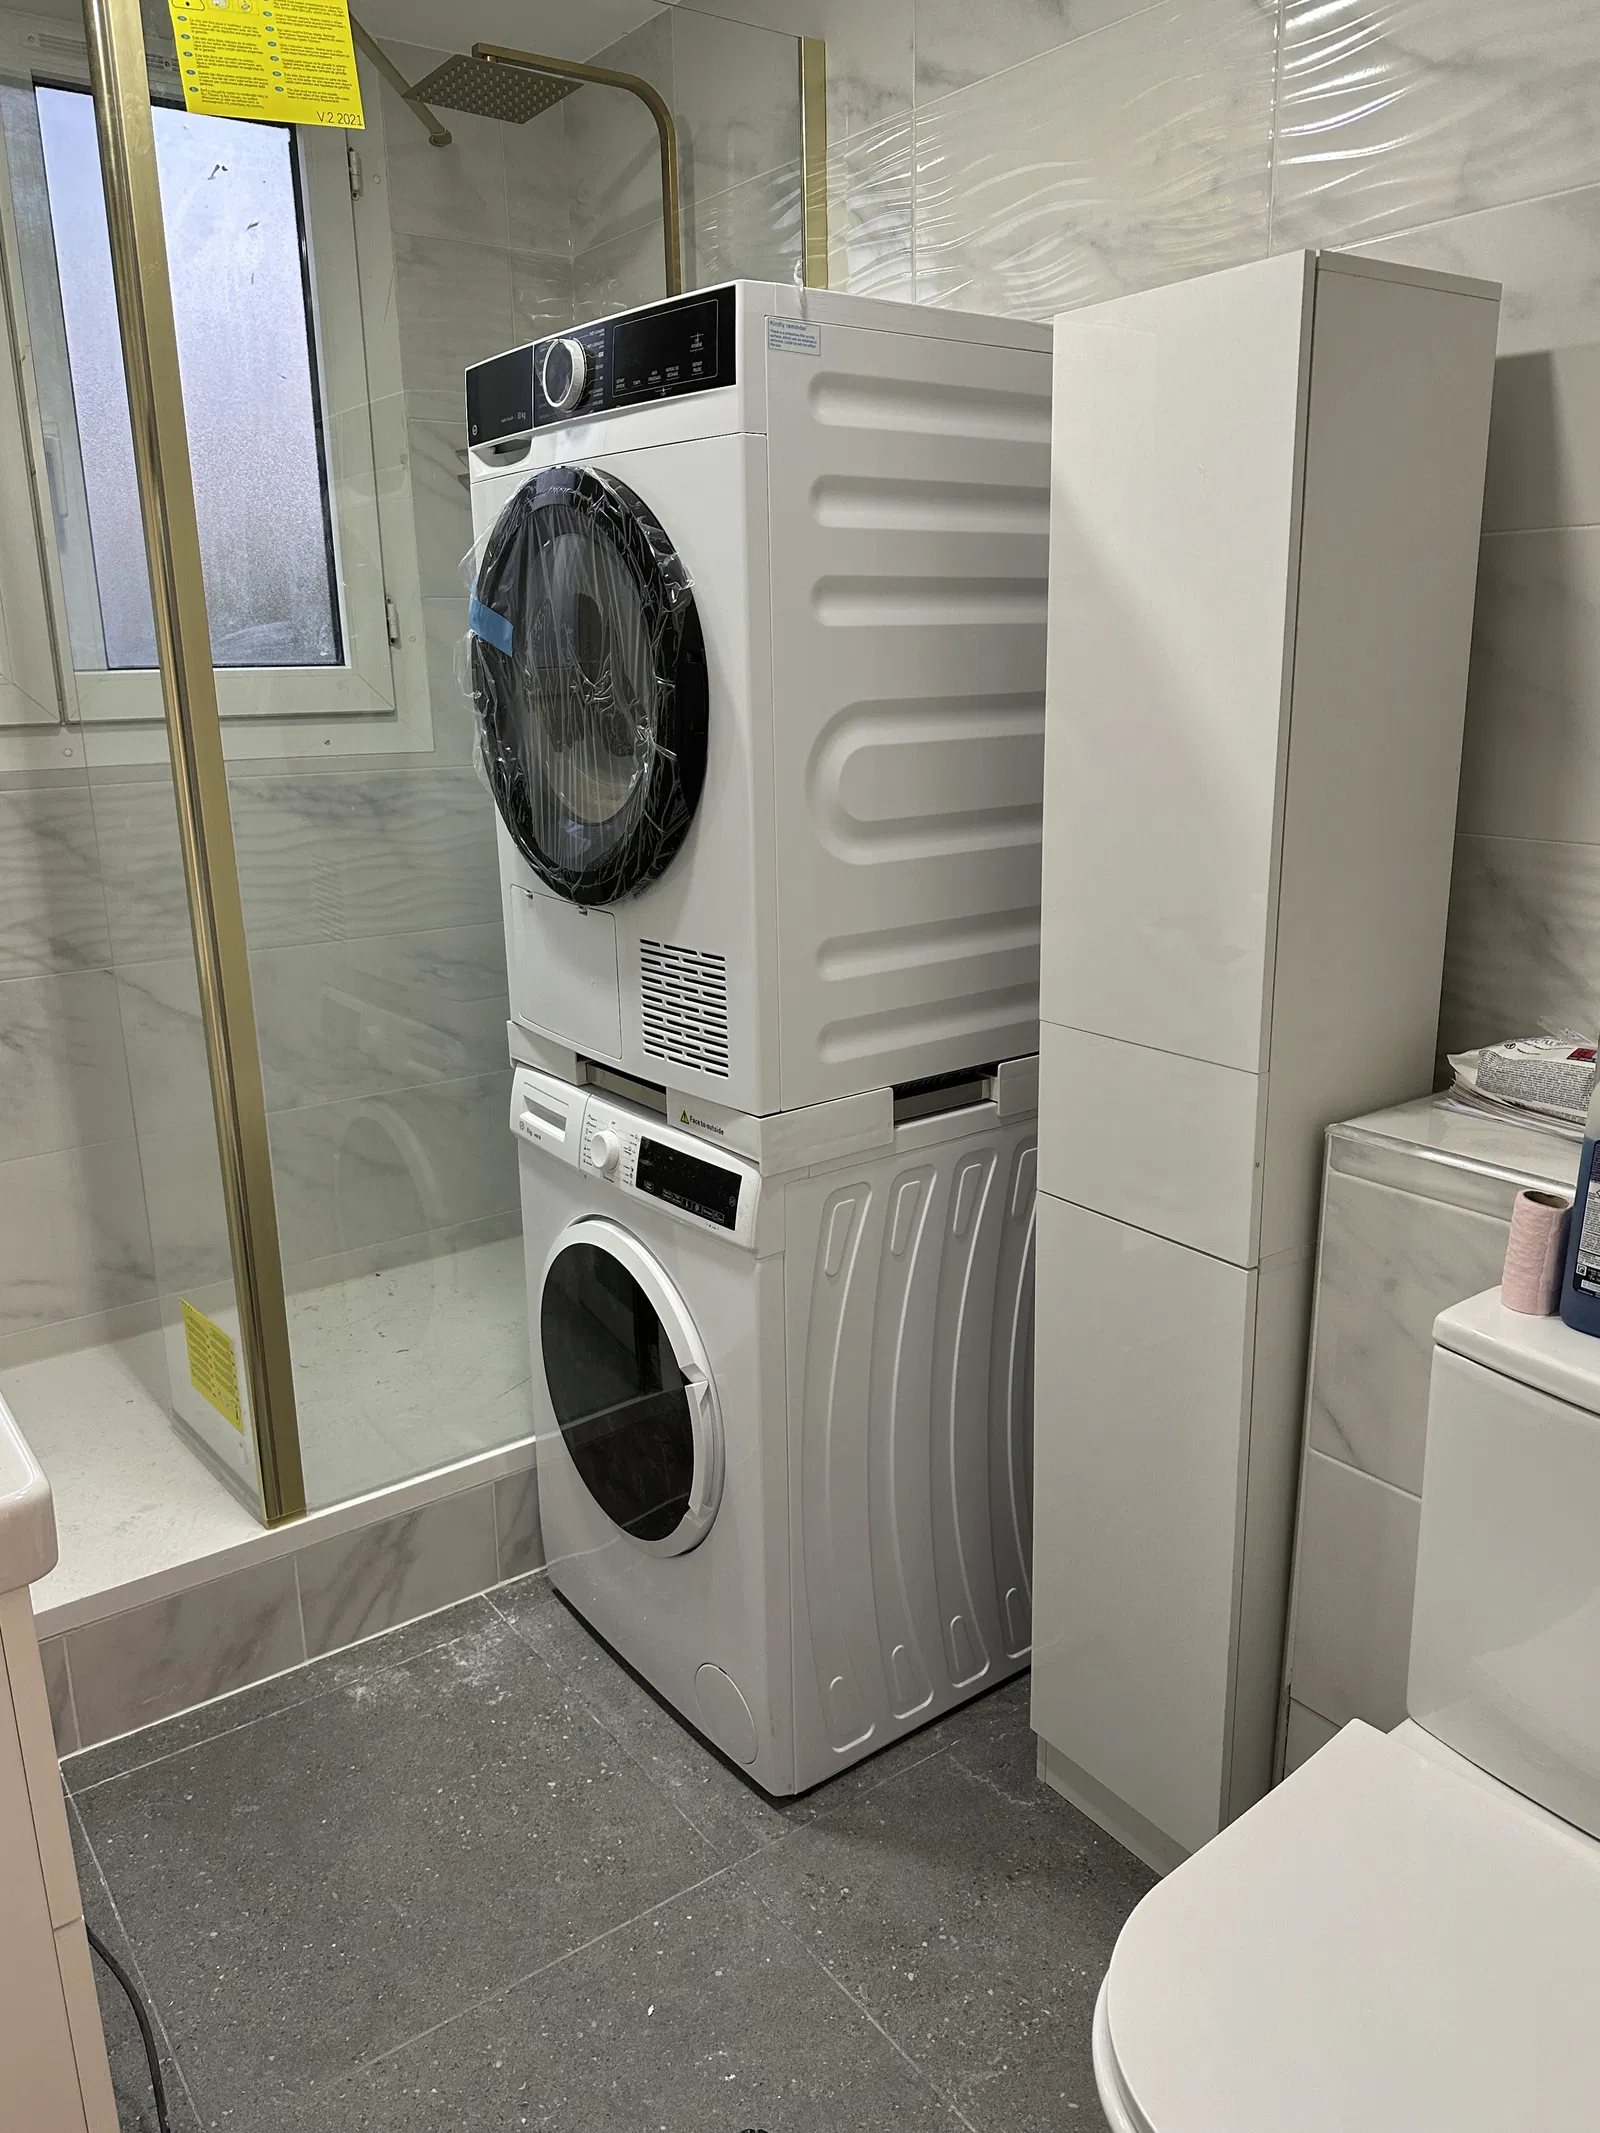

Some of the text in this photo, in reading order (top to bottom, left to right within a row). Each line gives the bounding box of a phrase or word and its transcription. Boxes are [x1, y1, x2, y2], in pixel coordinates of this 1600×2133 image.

[337, 112, 363, 126] 2021
[770, 320, 807, 331] Kindly reminder
[690, 1115, 700, 1126] Face
[707, 1124, 724, 1136] outside
